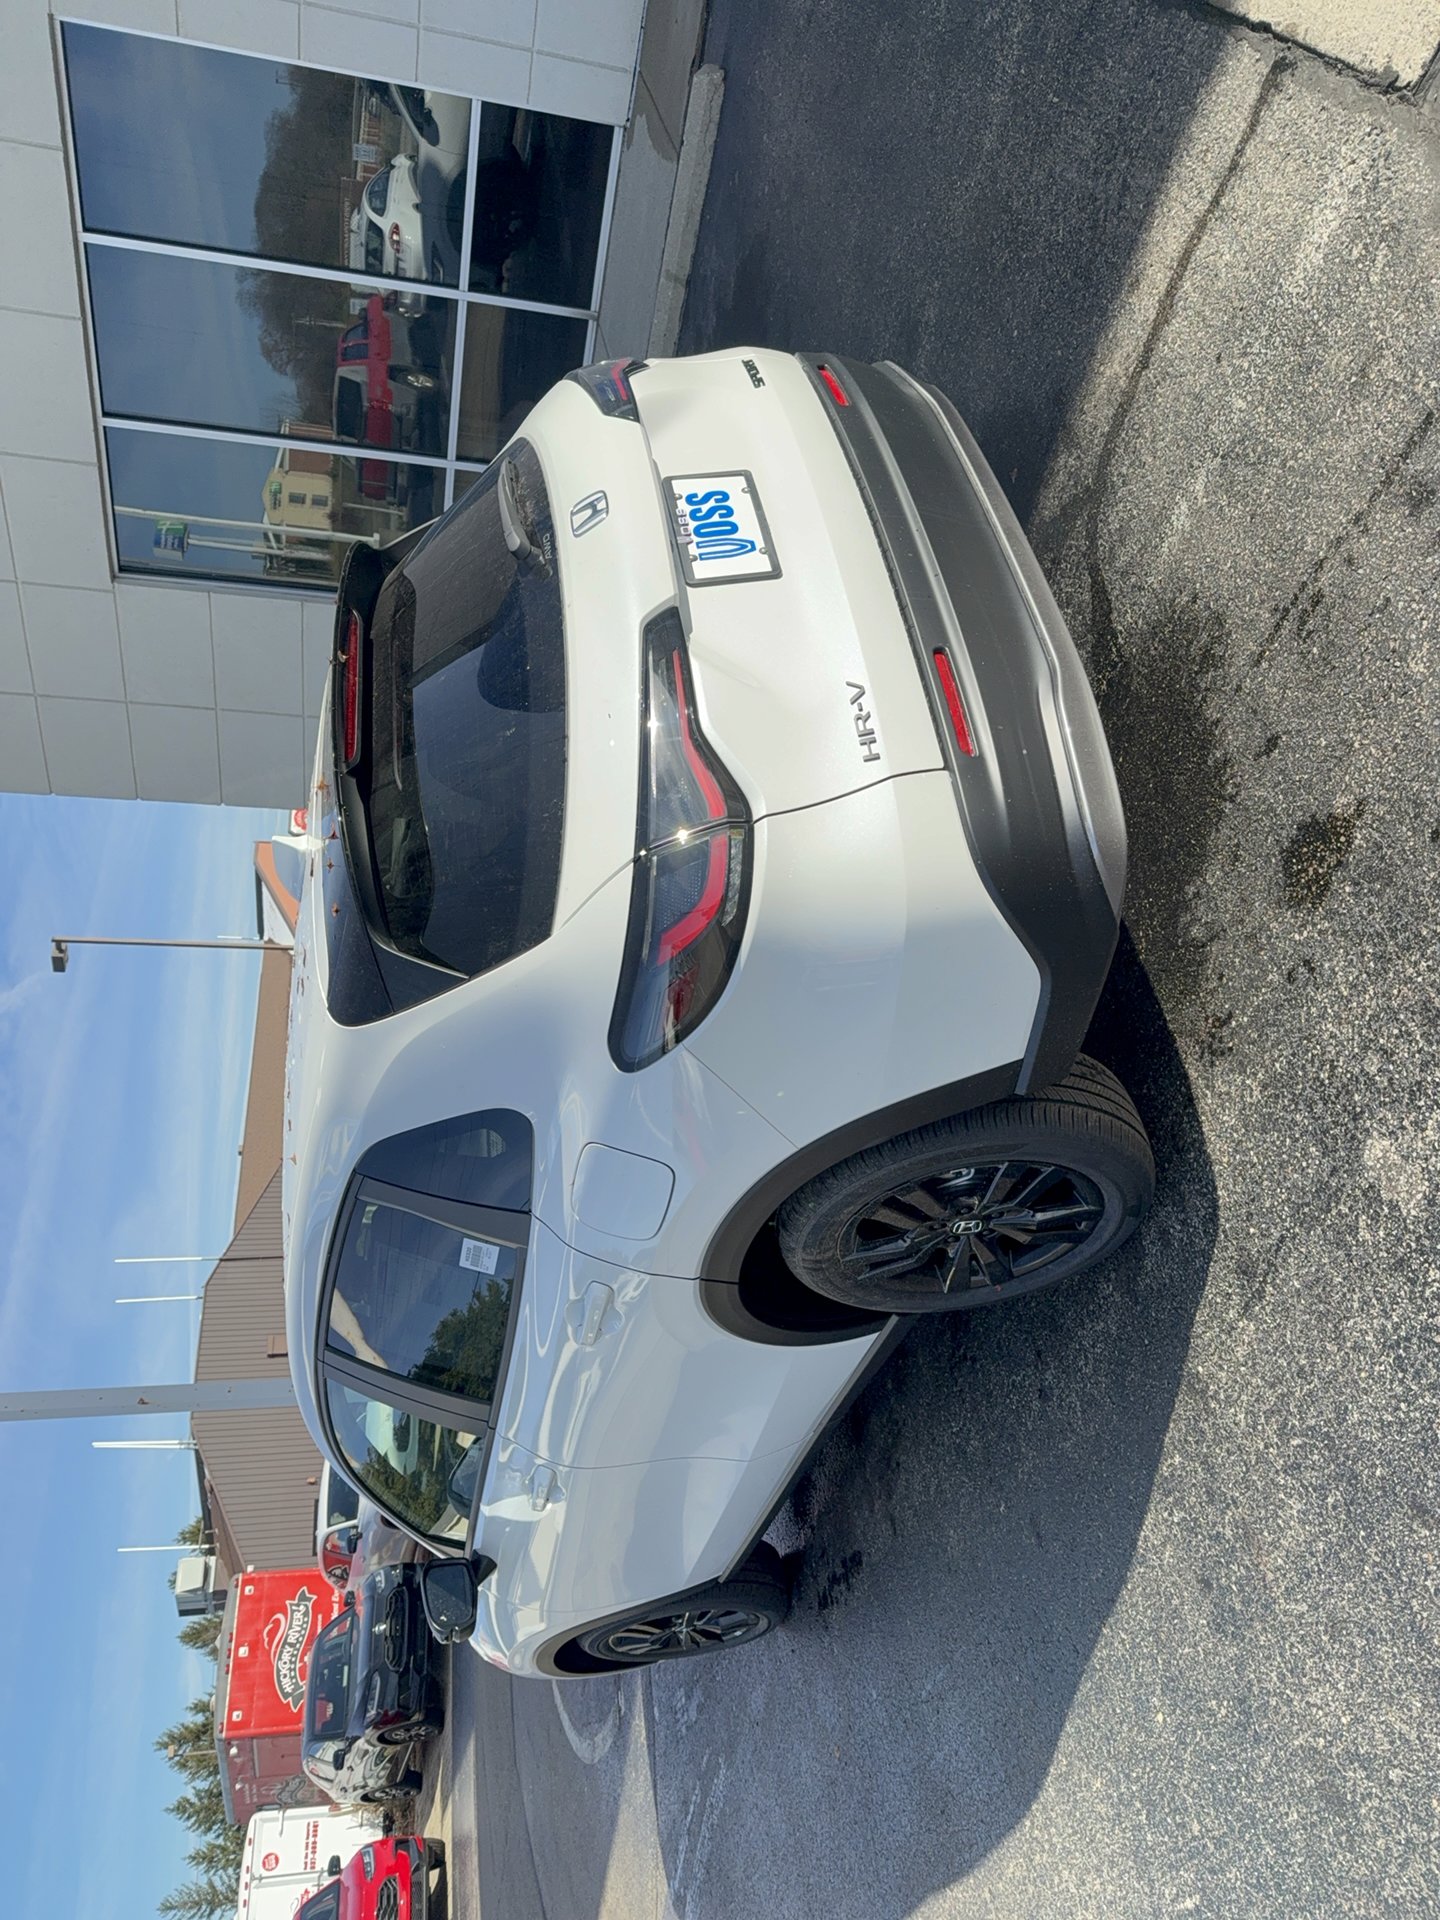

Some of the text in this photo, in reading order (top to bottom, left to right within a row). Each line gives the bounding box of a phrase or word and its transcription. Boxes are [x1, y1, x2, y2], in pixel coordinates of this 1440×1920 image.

[741, 359, 766, 388] SPORT
[542, 533, 552, 559] AWD
[685, 490, 756, 561] VOSS
[846, 680, 881, 762] HR-V
[285, 1604, 306, 1643] RIVER!
[278, 1644, 295, 1692] HICKORY
